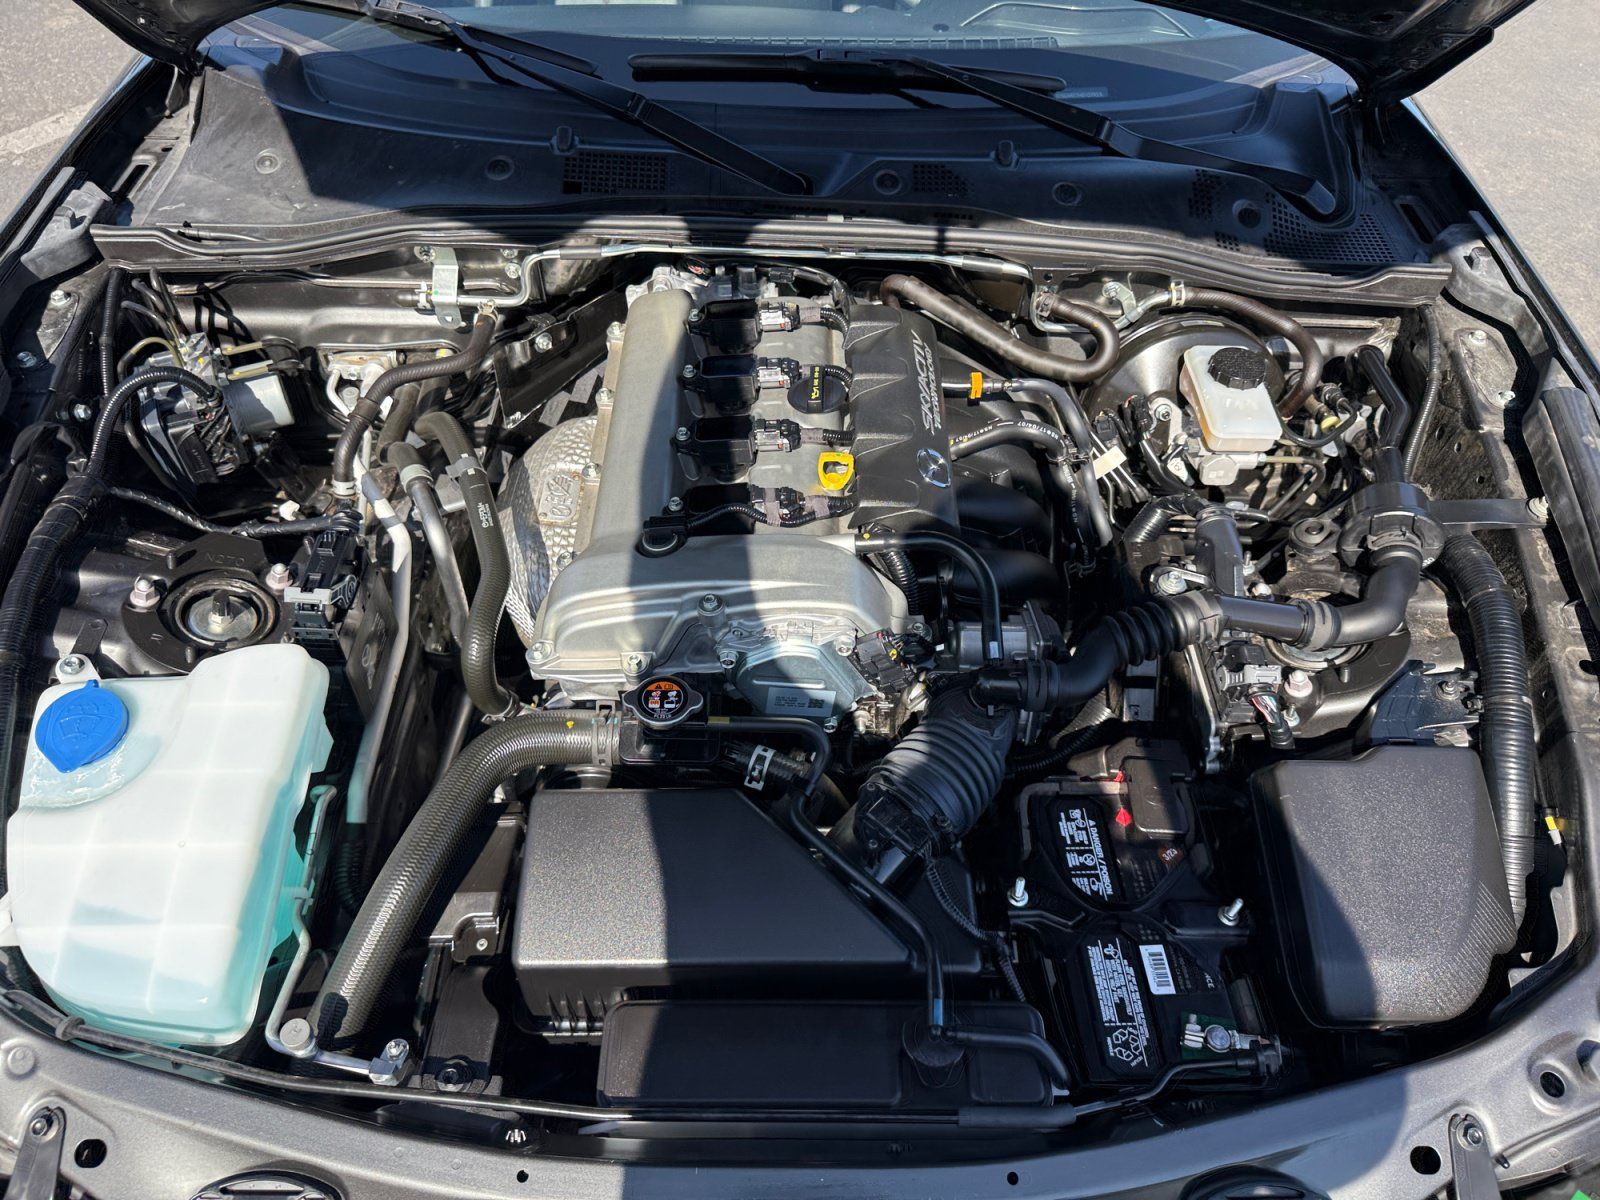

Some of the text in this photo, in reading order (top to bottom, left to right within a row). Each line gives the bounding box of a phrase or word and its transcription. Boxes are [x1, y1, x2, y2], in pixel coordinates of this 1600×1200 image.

[911, 329, 935, 436] SKYACTIV
[923, 342, 942, 430] TECHNOLOGY
[1090, 827, 1104, 859] DANGER
[1100, 864, 1113, 895] POISON
